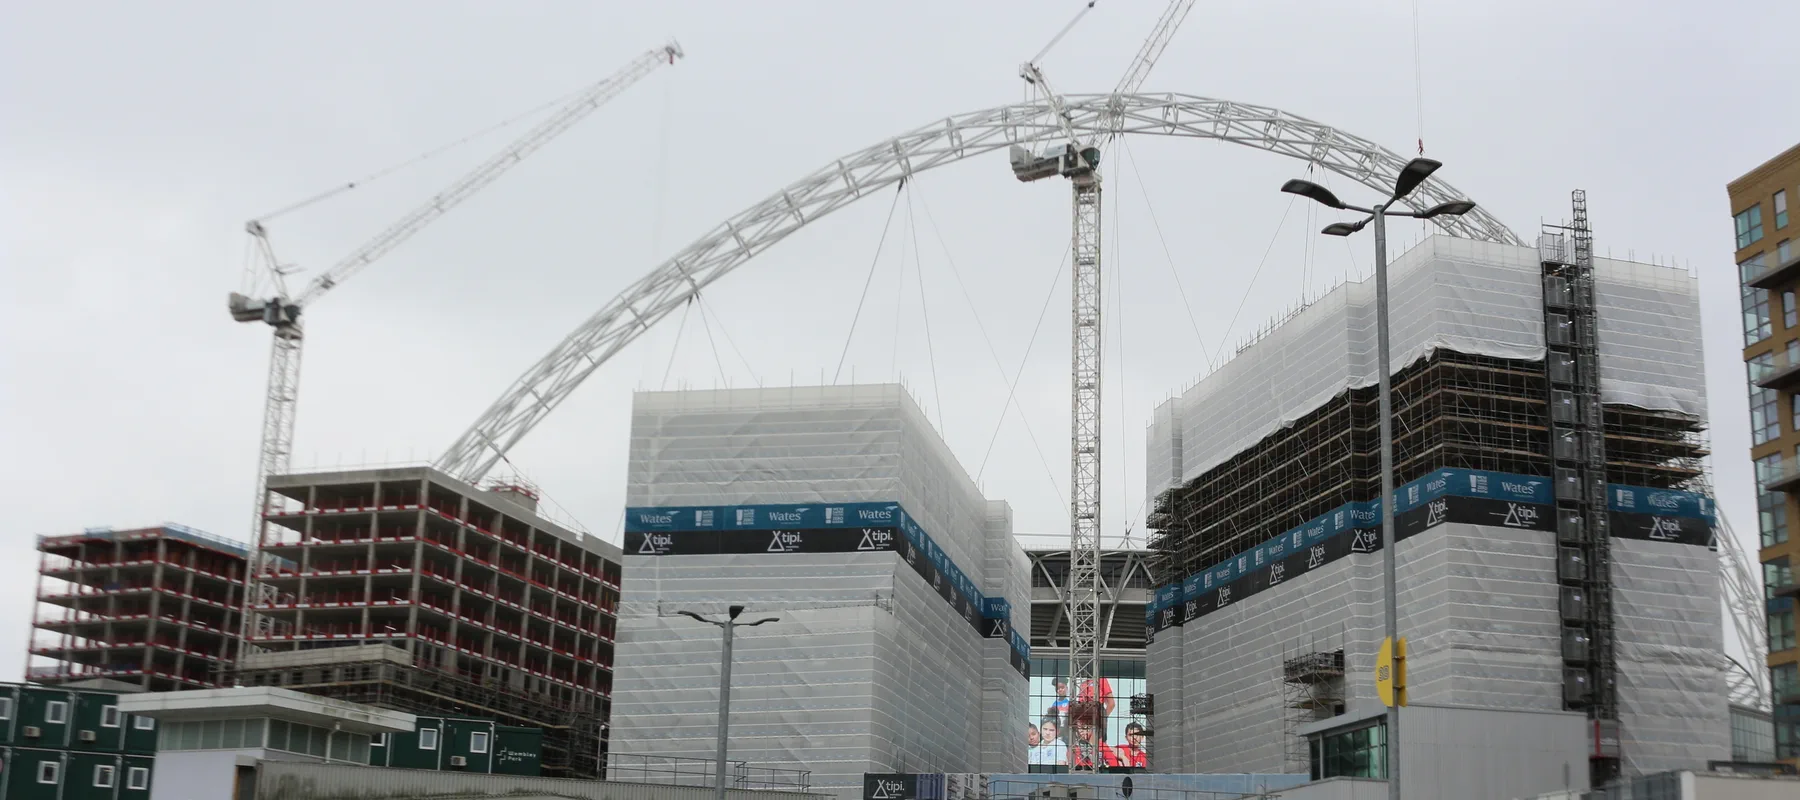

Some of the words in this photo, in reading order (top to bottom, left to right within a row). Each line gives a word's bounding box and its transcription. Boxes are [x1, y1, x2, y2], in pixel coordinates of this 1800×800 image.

[1502, 481, 1535, 495] Wates
[1647, 494, 1679, 508] Wates
[640, 514, 672, 523] Wates
[769, 511, 802, 521] Wates
[858, 510, 892, 519] Wates
[1350, 509, 1376, 520] Wates
[1517, 505, 1539, 520] tipi.
[872, 530, 893, 543] tipi.
[1307, 525, 1324, 538] Wates
[653, 535, 673, 547] tipi.
[781, 532, 802, 545] tipi.
[886, 780, 905, 793] tipi.
